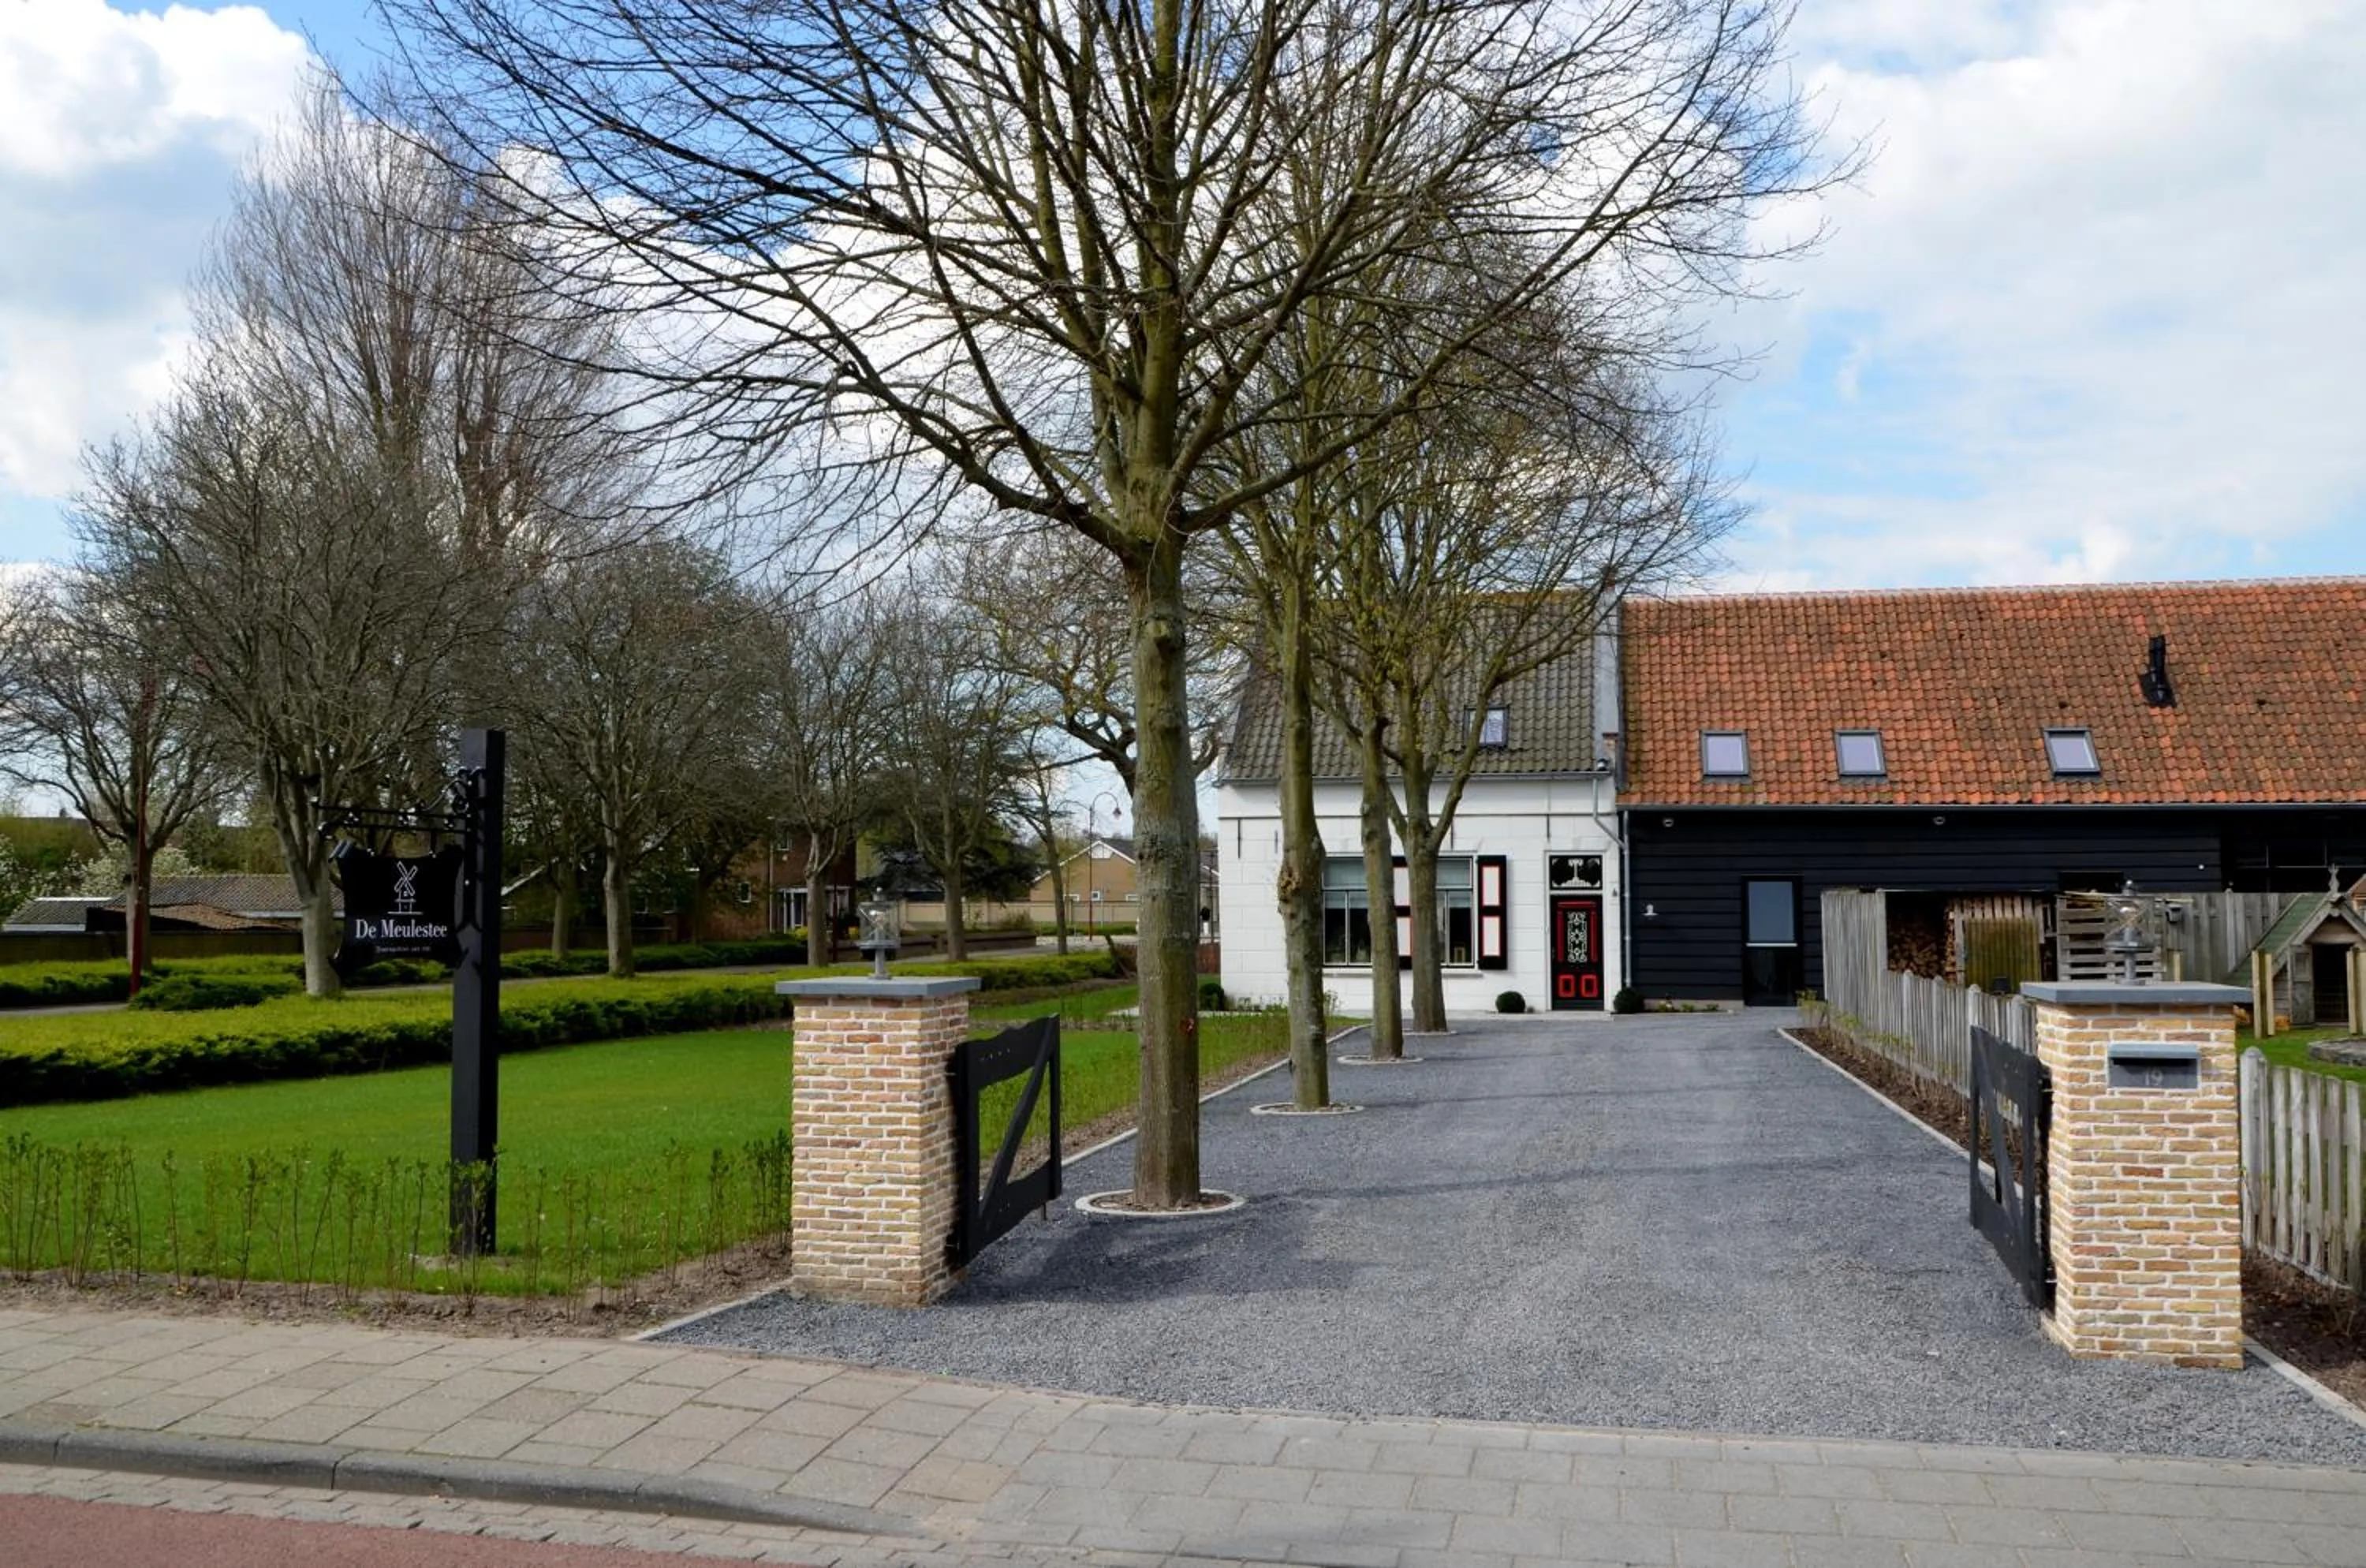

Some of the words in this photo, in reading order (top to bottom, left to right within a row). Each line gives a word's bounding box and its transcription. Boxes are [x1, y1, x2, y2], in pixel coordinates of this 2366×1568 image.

[355, 918, 377, 939] De
[381, 919, 447, 938] Meulestee
[2144, 1069, 2163, 1086] 19
